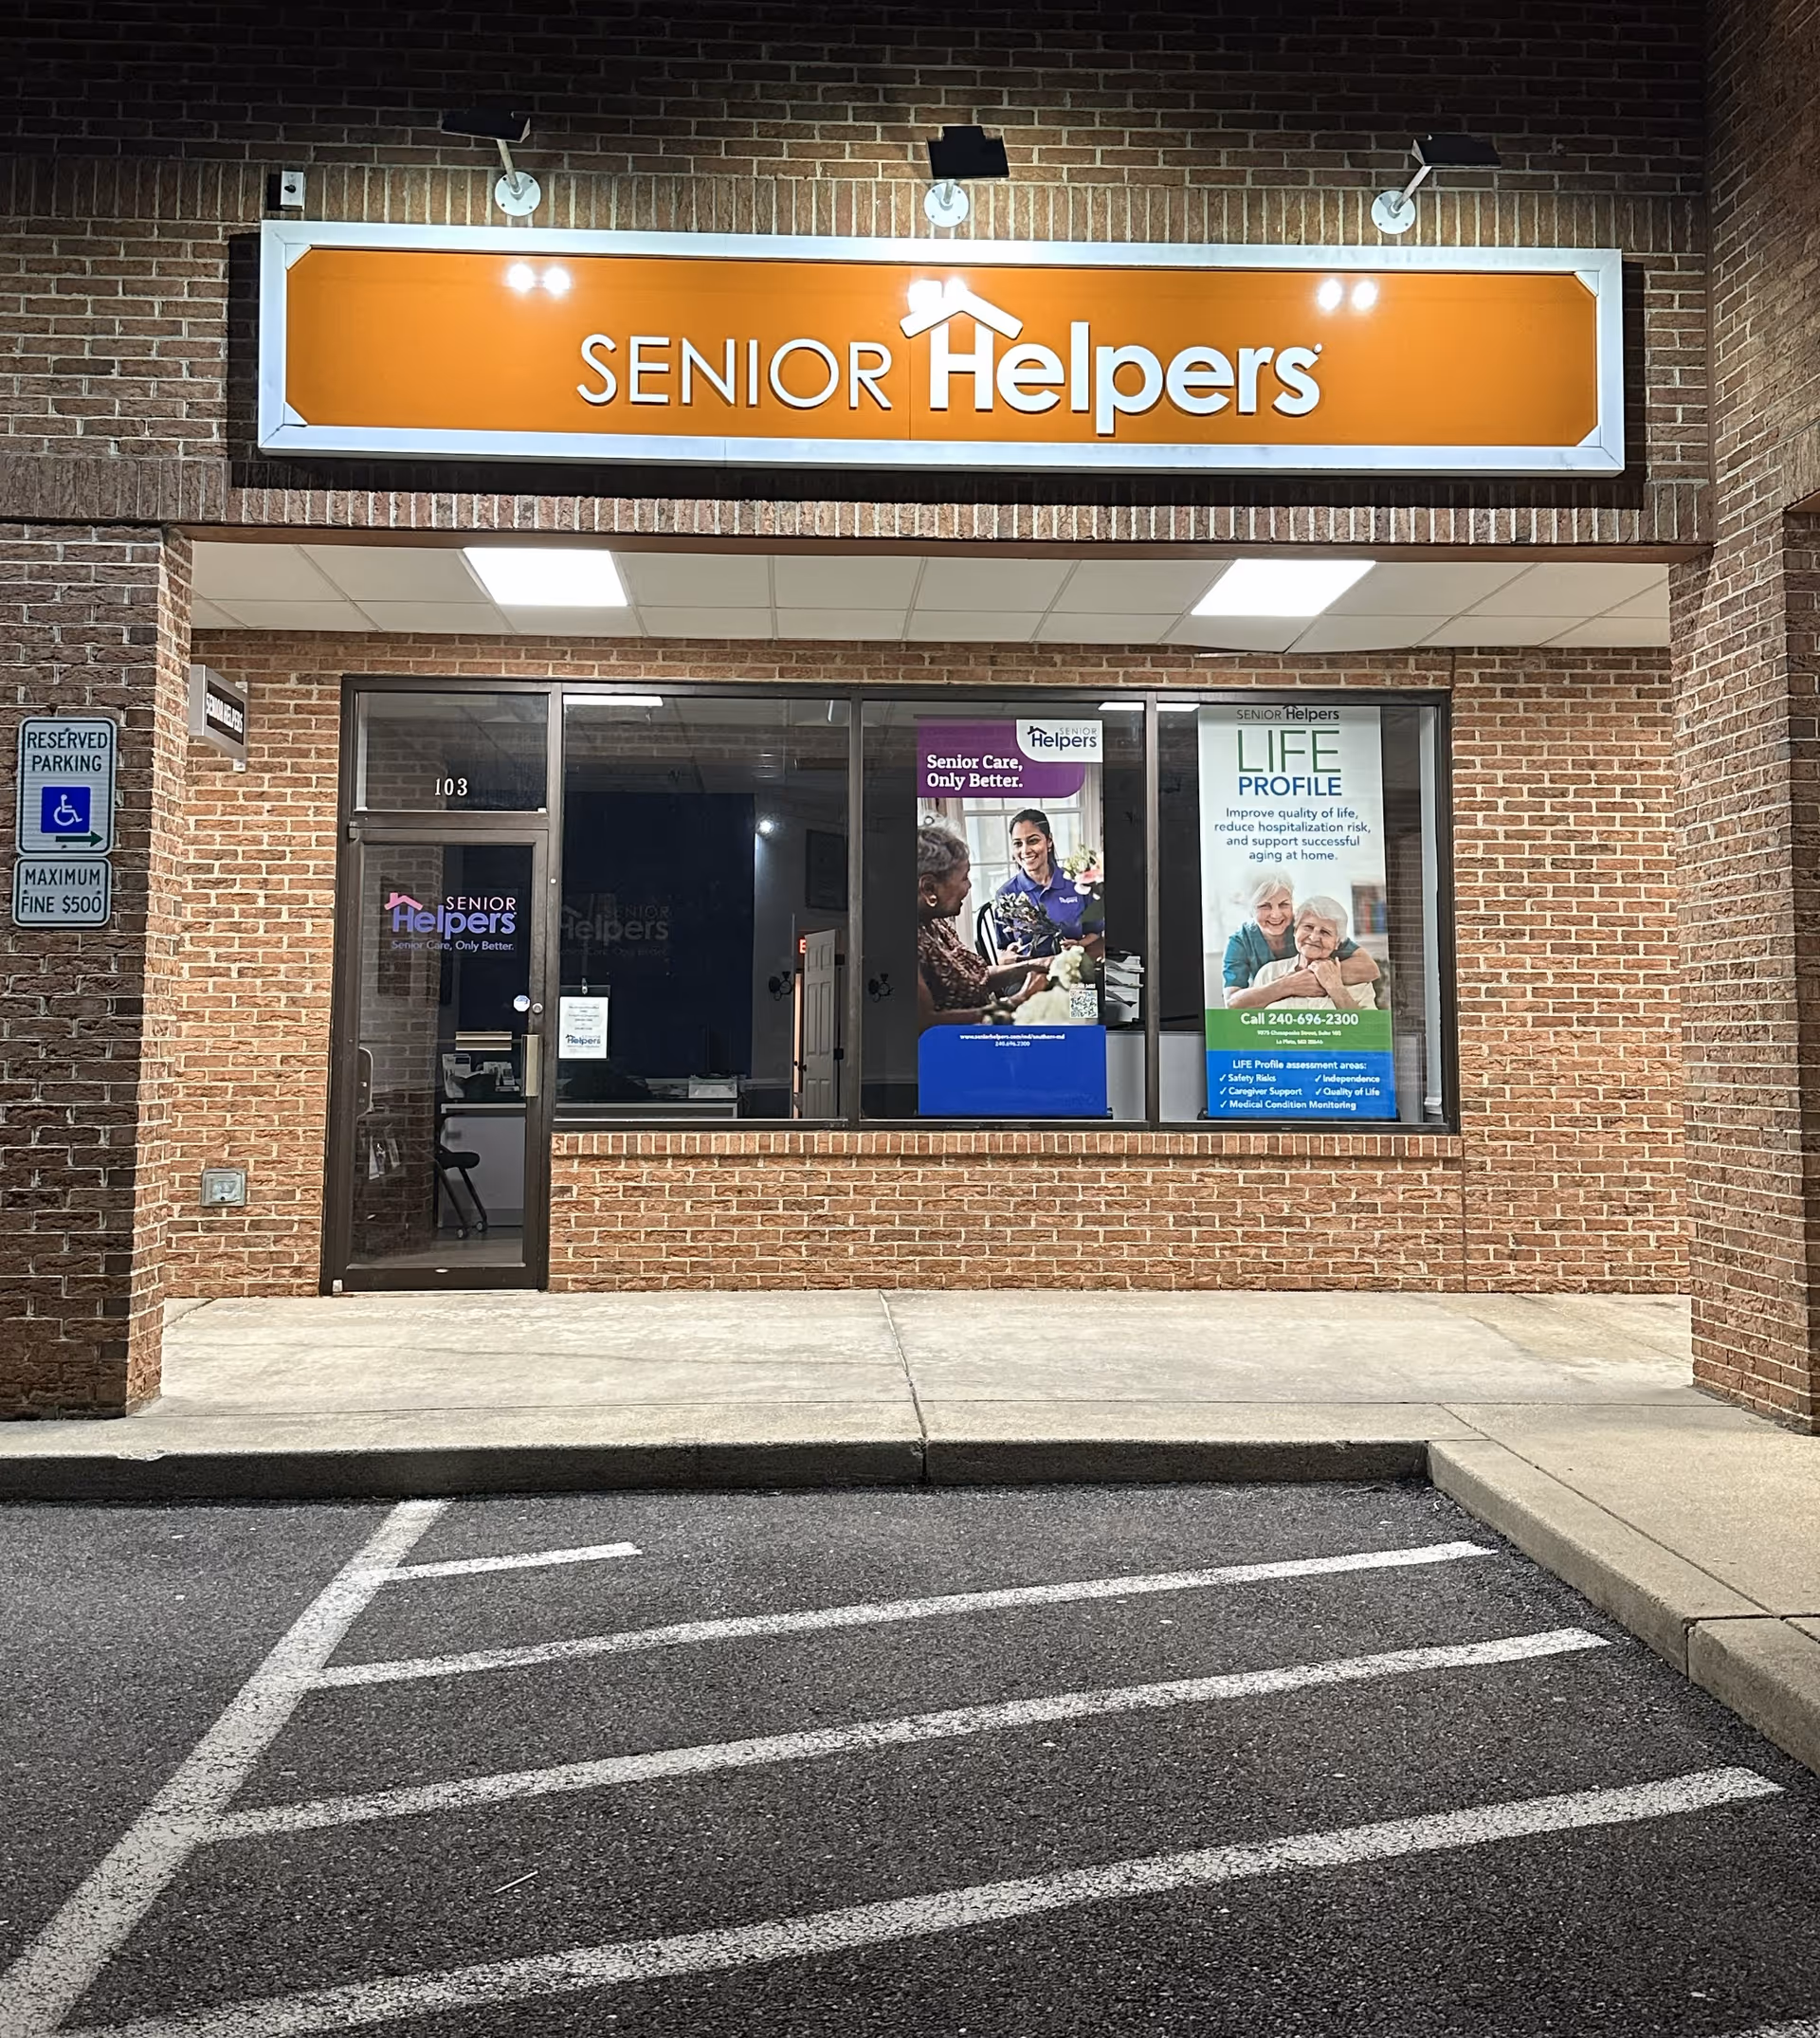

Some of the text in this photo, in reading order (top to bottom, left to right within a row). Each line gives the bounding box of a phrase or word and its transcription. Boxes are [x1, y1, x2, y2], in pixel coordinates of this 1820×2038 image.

[577, 320, 1320, 436] SENIOR Helpers
[1236, 707, 1339, 722] SENIOR Helpers
[27, 732, 108, 749] RESERVED
[1031, 733, 1097, 751] Helpers
[1237, 730, 1341, 773] LIFE
[31, 755, 102, 772] PARKING
[927, 755, 1023, 772] Senior Care,
[434, 778, 468, 796] 103
[927, 773, 1023, 791] Only Better.
[1239, 776, 1342, 795] PROFILE
[1227, 808, 1358, 820] Improve quality of life,
[1214, 822, 1371, 834] reduce hospitalization risk,
[1227, 835, 1359, 848] and support successful
[1248, 850, 1338, 863] aging at home.
[25, 868, 100, 885] MAXIMUM
[21, 896, 102, 914] FINE $500
[446, 896, 517, 911] SENIOR
[392, 904, 517, 940] Helpers
[391, 940, 515, 953] Senior Care, Only Better.
[1241, 1013, 1358, 1026] Call 240-696-2300
[1232, 1060, 1252, 1069] LIFE
[1255, 1060, 1283, 1069] Profile
[1286, 1061, 1338, 1069] assessment
[1228, 1074, 1254, 1083] Safety
[1323, 1074, 1380, 1083] Independence
[1228, 1087, 1302, 1097] Caregiver Support
[1323, 1088, 1353, 1098] Quality
[1229, 1100, 1356, 1111] Medical Condition Monitoring
